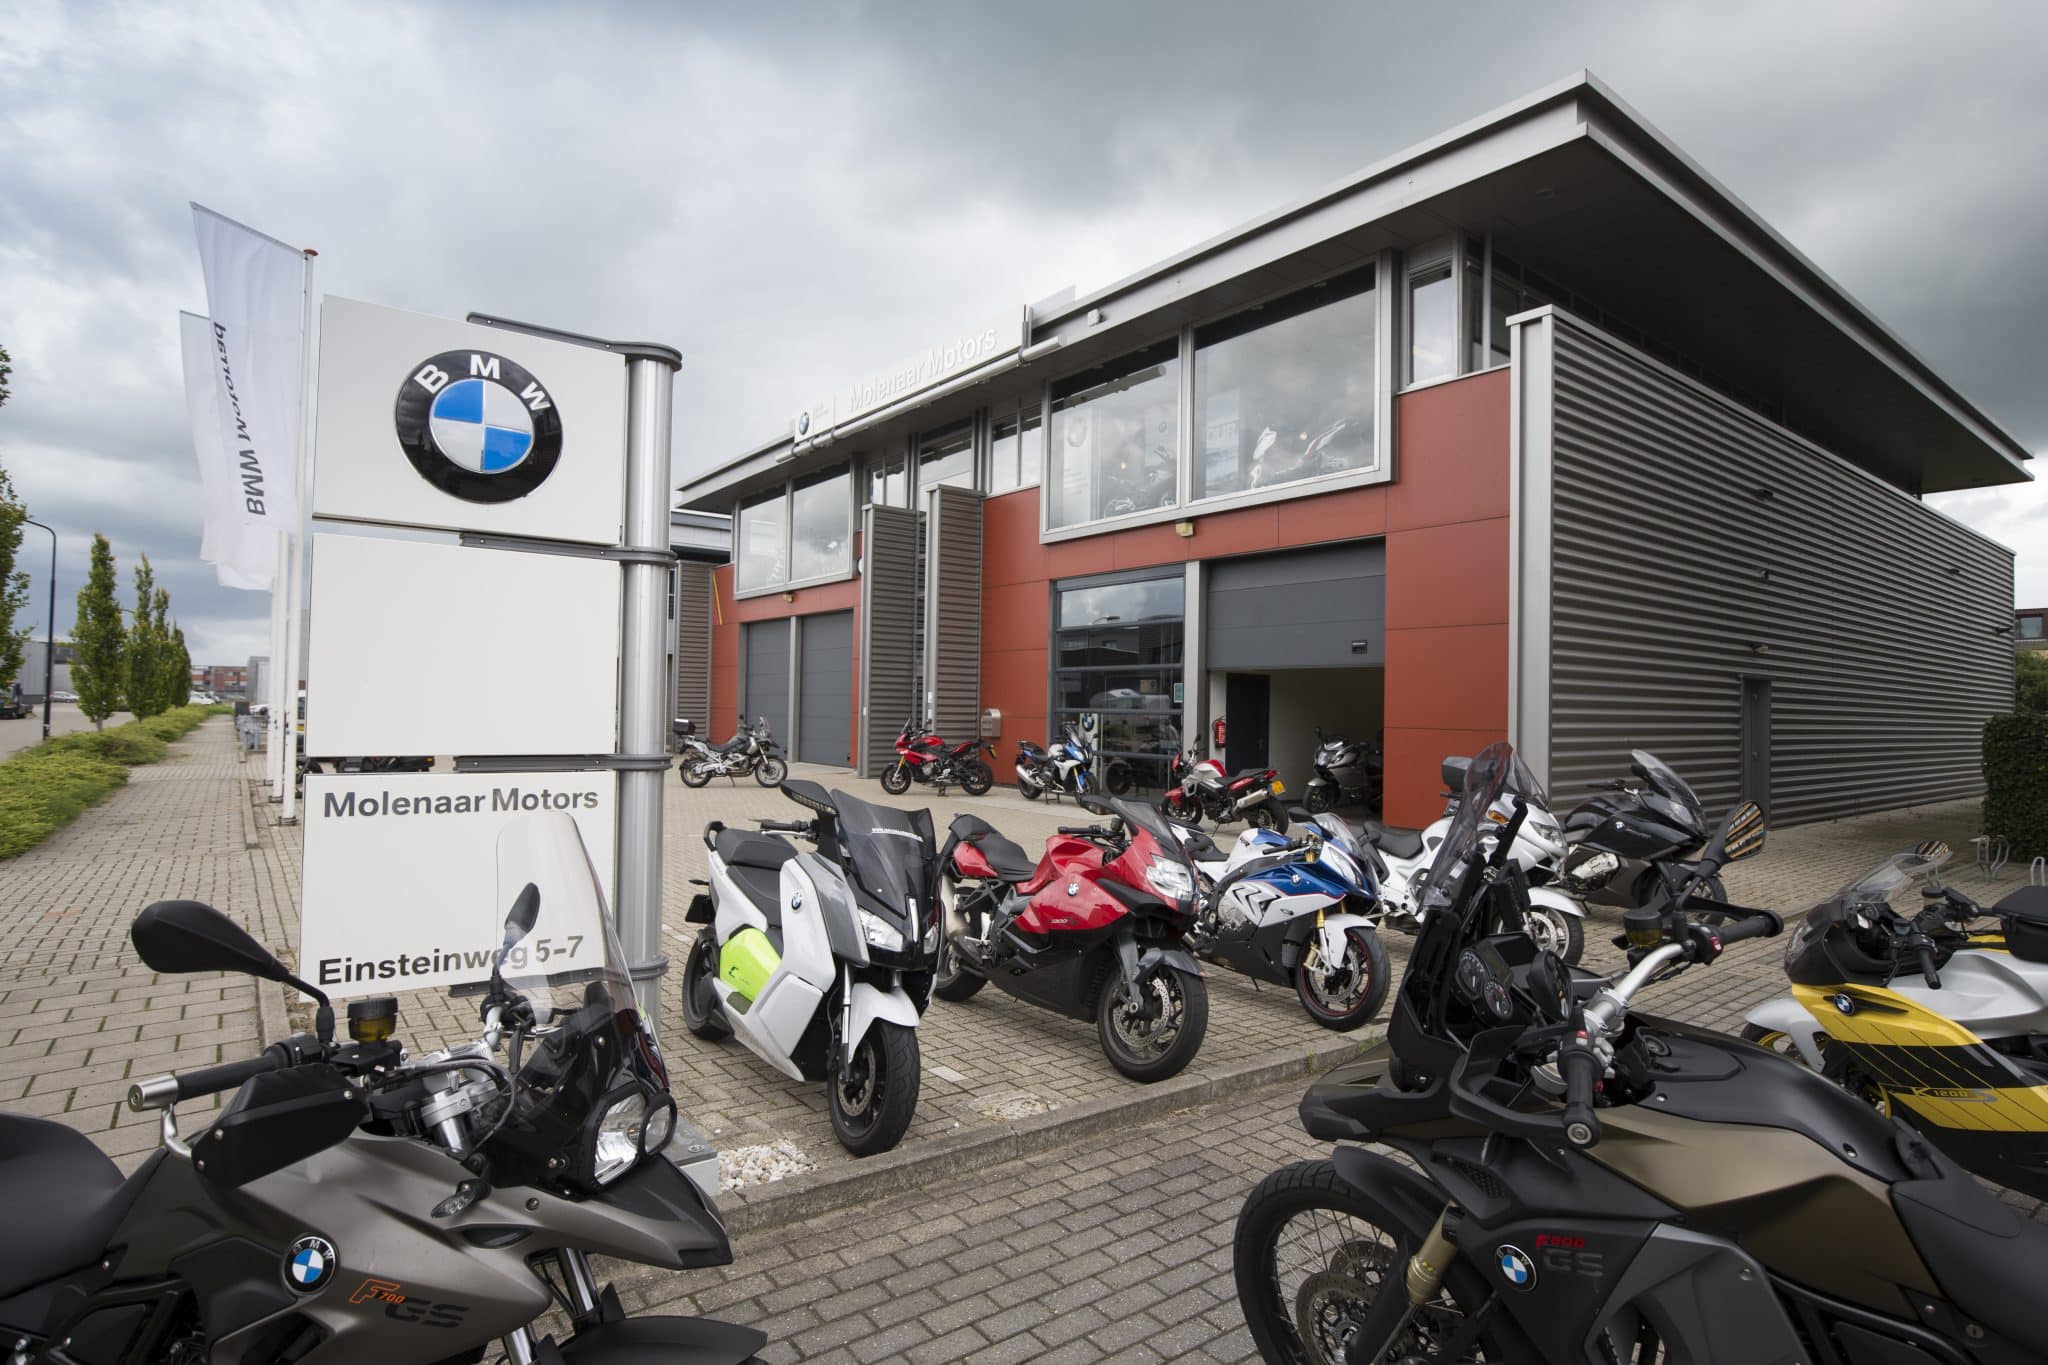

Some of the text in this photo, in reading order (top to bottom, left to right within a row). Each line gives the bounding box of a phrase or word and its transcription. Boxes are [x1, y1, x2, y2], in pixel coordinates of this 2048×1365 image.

[413, 354, 552, 411] BMW
[849, 329, 997, 411] Molenaar Motors
[323, 787, 599, 818] Molenaar Motors
[535, 935, 584, 963] 5-7
[1544, 1247, 1604, 1277] GS
[379, 1292, 406, 1304] 700
[385, 1296, 470, 1328] GS
